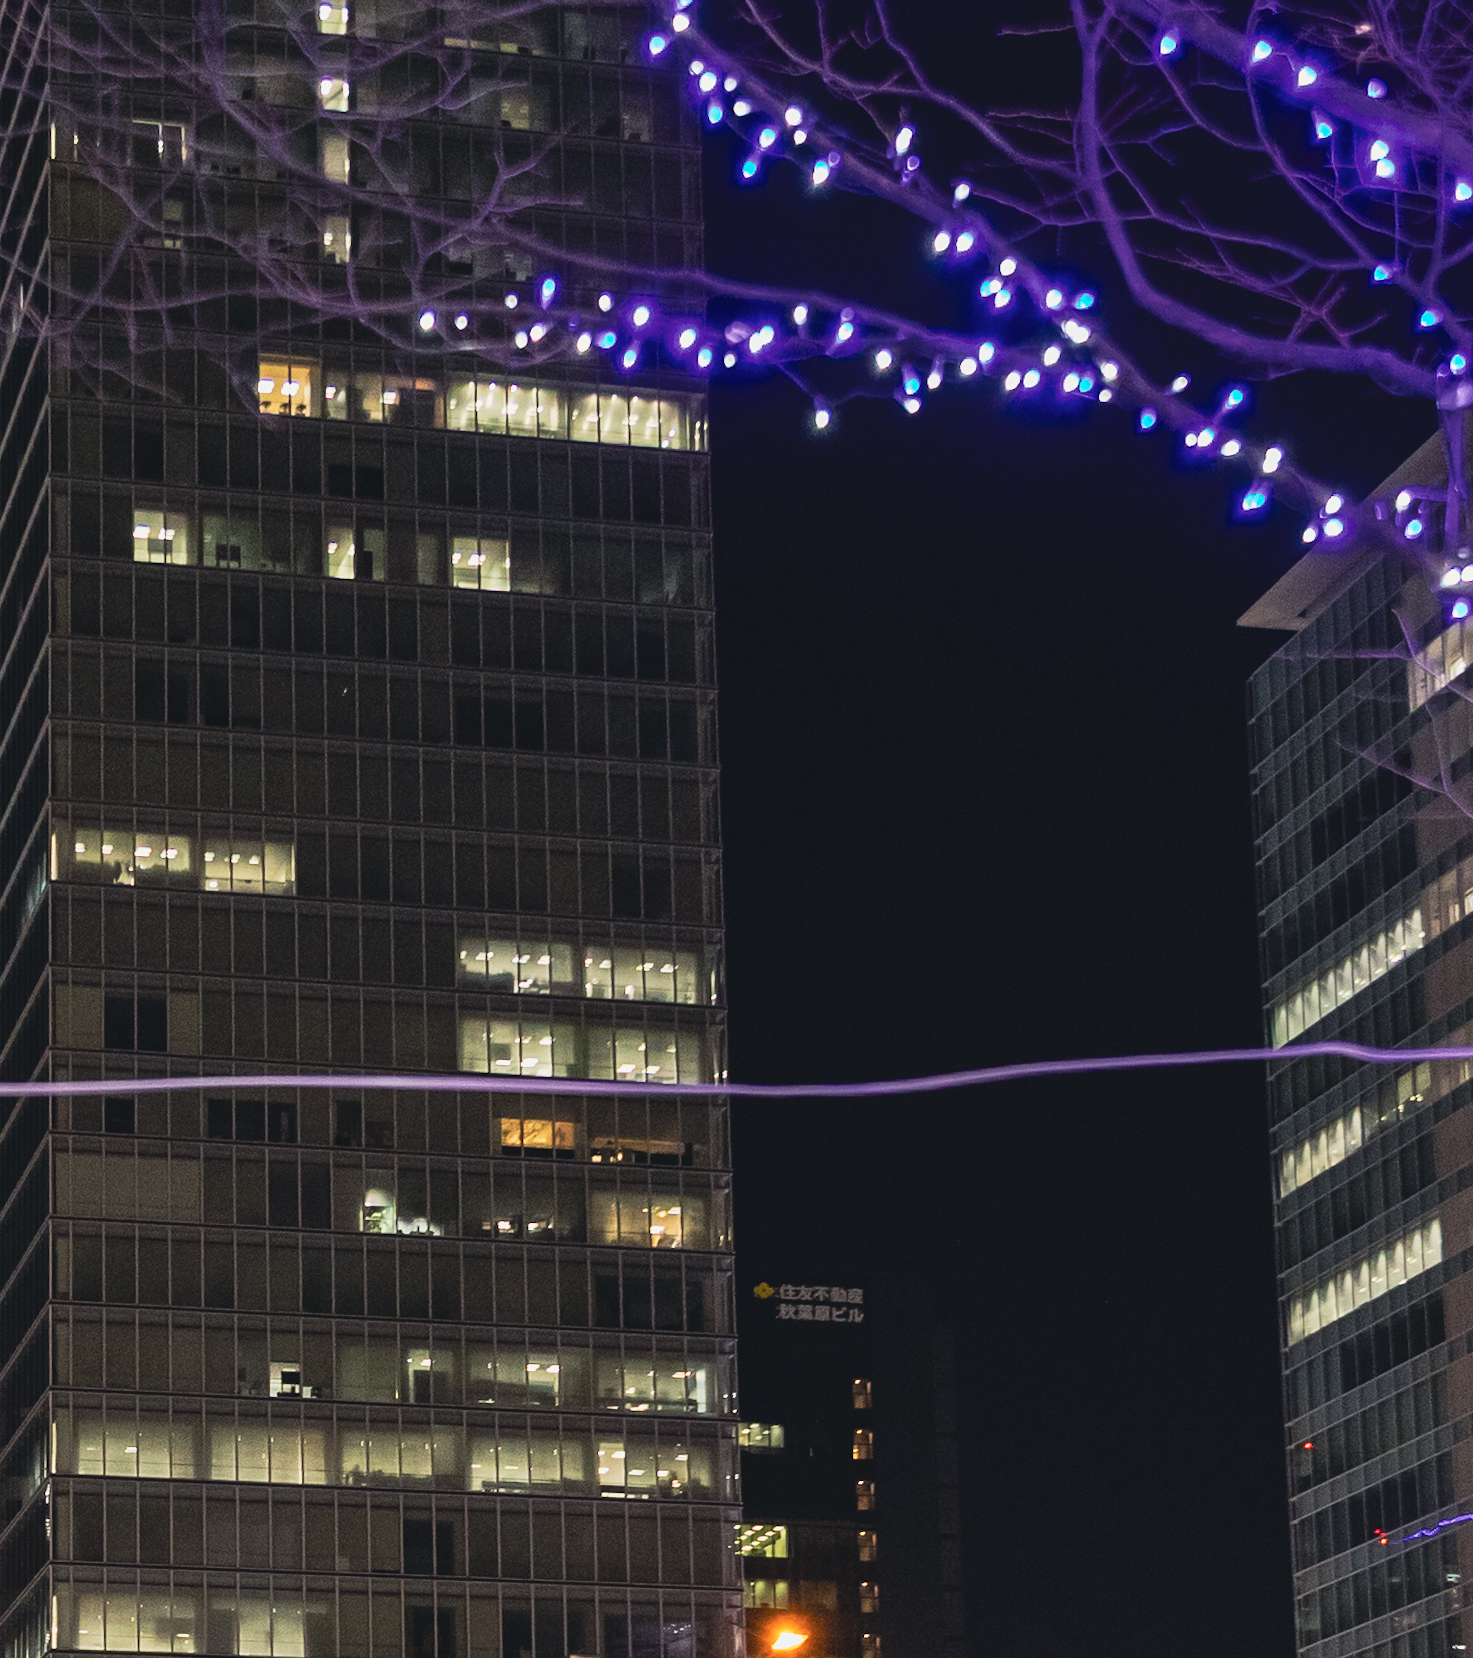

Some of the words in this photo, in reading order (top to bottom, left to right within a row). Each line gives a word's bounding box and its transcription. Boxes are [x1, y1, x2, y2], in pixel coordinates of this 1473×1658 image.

[780, 1284, 864, 1304] 住友不動産
[775, 1303, 865, 1323] 秋葉原ビル
